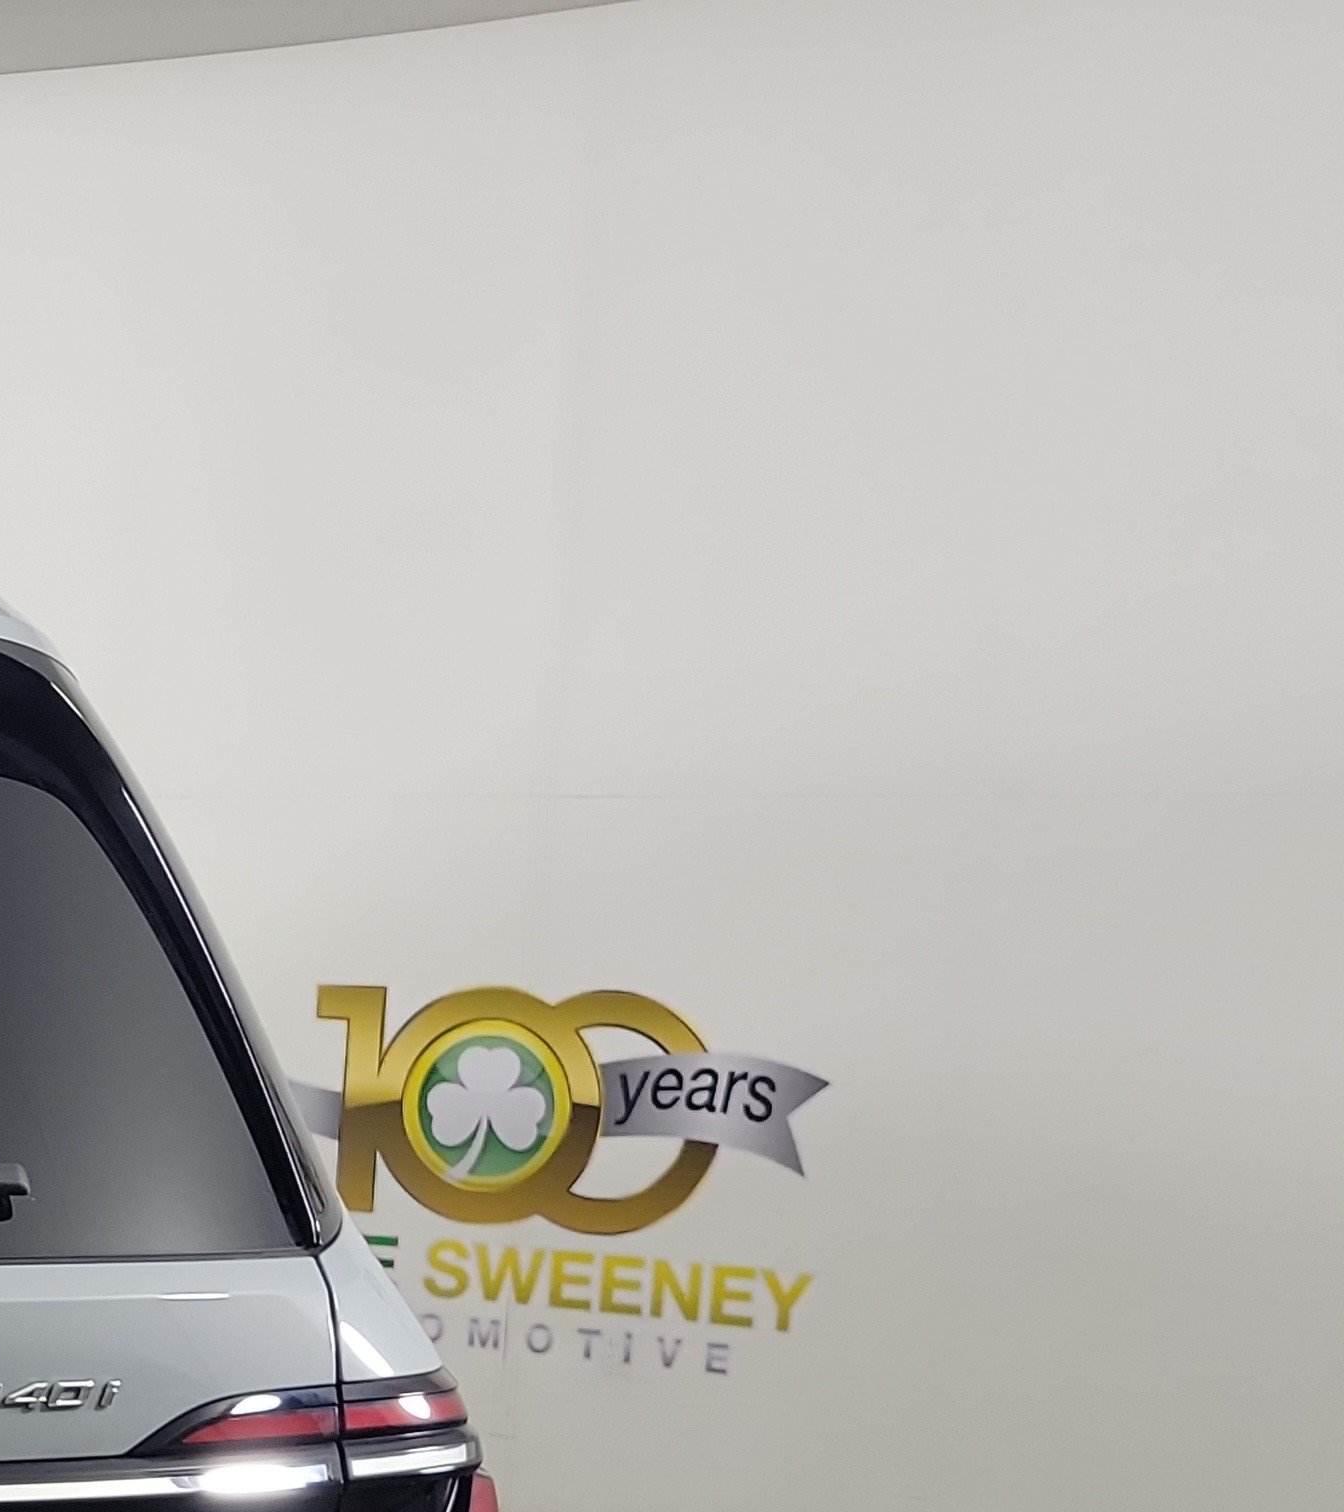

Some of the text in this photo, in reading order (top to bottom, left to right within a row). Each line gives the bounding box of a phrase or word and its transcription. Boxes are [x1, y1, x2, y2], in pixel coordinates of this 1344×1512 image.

[316, 984, 777, 1235] 100 years
[423, 1238, 814, 1332] SWEENEY
[419, 1313, 730, 1376] OMOTIVE
